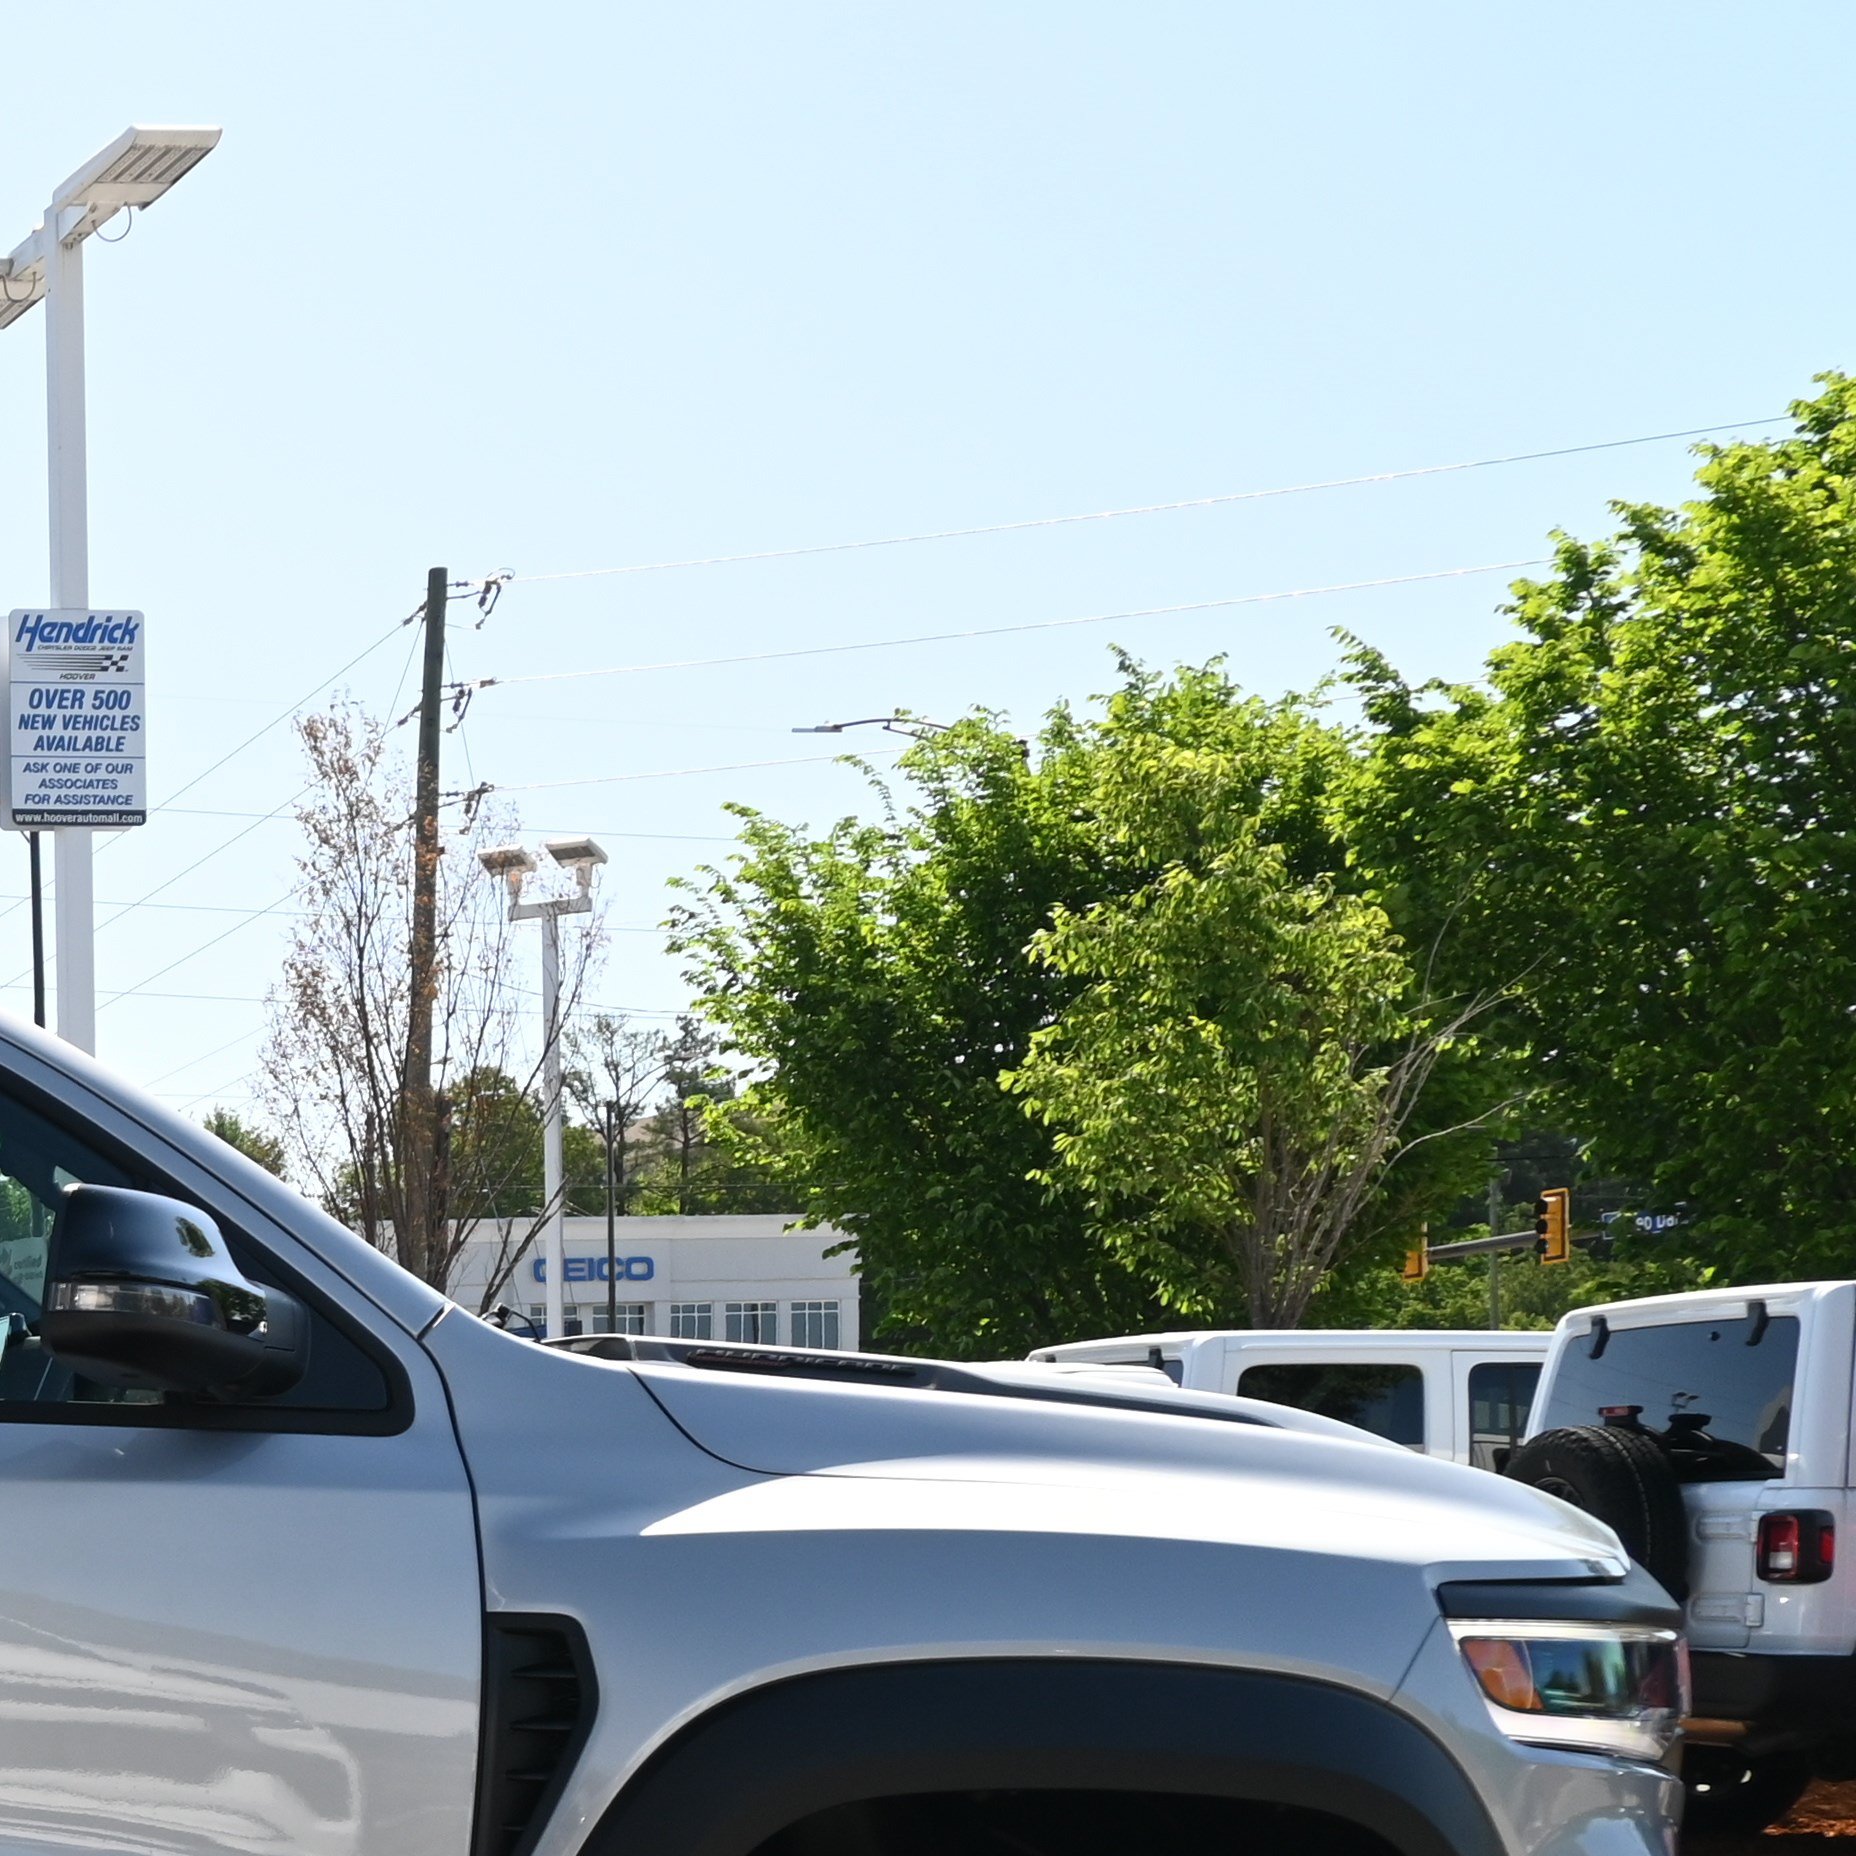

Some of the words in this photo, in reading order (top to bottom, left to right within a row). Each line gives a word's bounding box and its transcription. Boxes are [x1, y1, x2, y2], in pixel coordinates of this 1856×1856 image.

[15, 614, 139, 652] Hendrick
[28, 688, 85, 710] OVER
[91, 689, 131, 710] 500
[18, 714, 57, 730] NEW
[62, 714, 141, 731] VEHICLES
[33, 735, 126, 752] AVAILABLE
[23, 762, 50, 773] ASK
[53, 763, 81, 773] ONE
[84, 763, 103, 774] OF
[105, 763, 134, 774] OUR
[39, 778, 119, 790] ASSOCIATES
[24, 794, 51, 804] FOR
[54, 794, 134, 806] ASSISTANCE
[15, 813, 143, 823] www.hooverautomall.com
